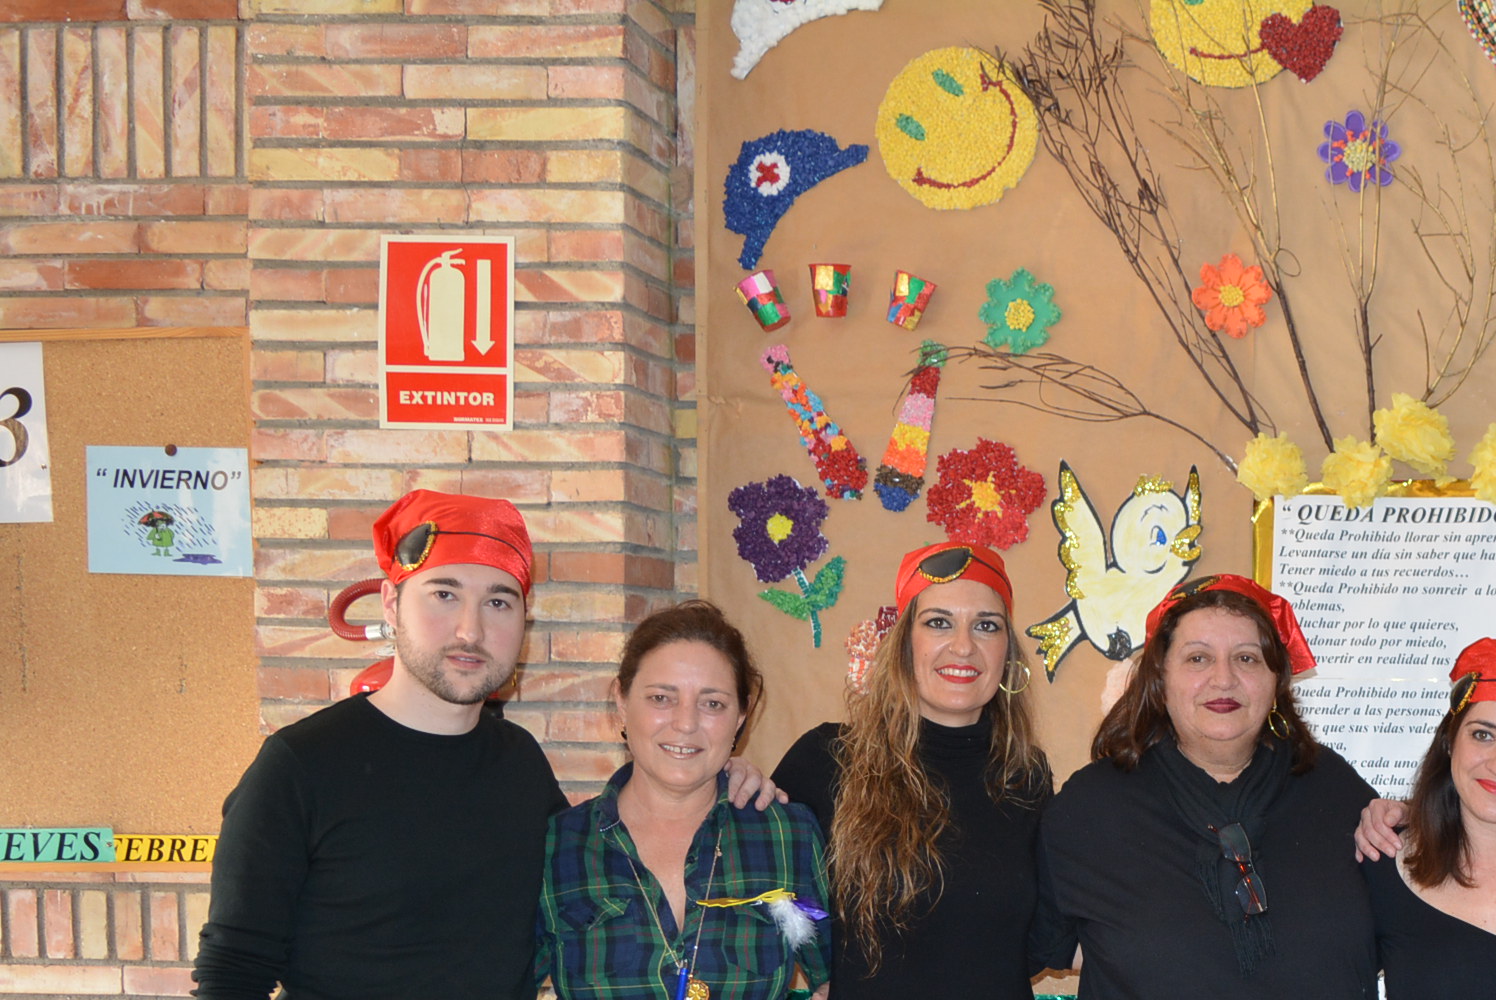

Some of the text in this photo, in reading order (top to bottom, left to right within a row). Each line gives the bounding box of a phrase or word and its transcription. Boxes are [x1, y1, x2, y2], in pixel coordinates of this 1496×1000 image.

[399, 390, 495, 406] EXTINTOR
[1339, 530, 1401, 542] Prohibido
[1404, 531, 1440, 543] llorar
[1443, 532, 1461, 543] sin
[1279, 546, 1348, 559] Levantarse
[1351, 551, 1368, 559] un
[1395, 549, 1413, 560] sin
[1416, 549, 1450, 560] saber
[1453, 552, 1477, 563] que
[1279, 563, 1316, 576] Tener
[1318, 565, 1357, 577] miedo
[1360, 569, 1367, 577] a
[1371, 567, 1390, 577] tus
[1338, 583, 1399, 595] Prohibido
[1402, 585, 1419, 594] no
[1474, 587, 1483, 596] a
[1291, 599, 1345, 613] oblemas,
[1299, 617, 1459, 632] luchar por lo que quieres,
[1307, 635, 1447, 650] donar todo por miedo,
[1314, 652, 1450, 665] nvertir en realidad tus
[1335, 687, 1398, 699] Prohibido
[1401, 690, 1418, 699] no
[1295, 704, 1445, 719] prender a las personas,
[1322, 724, 1345, 735] que
[1349, 725, 1369, 733] sus
[1373, 722, 1404, 733] vidas
[1360, 756, 1390, 768] cada
[1394, 760, 1419, 768] uno
[0, 831, 219, 862] EVES EBRE
